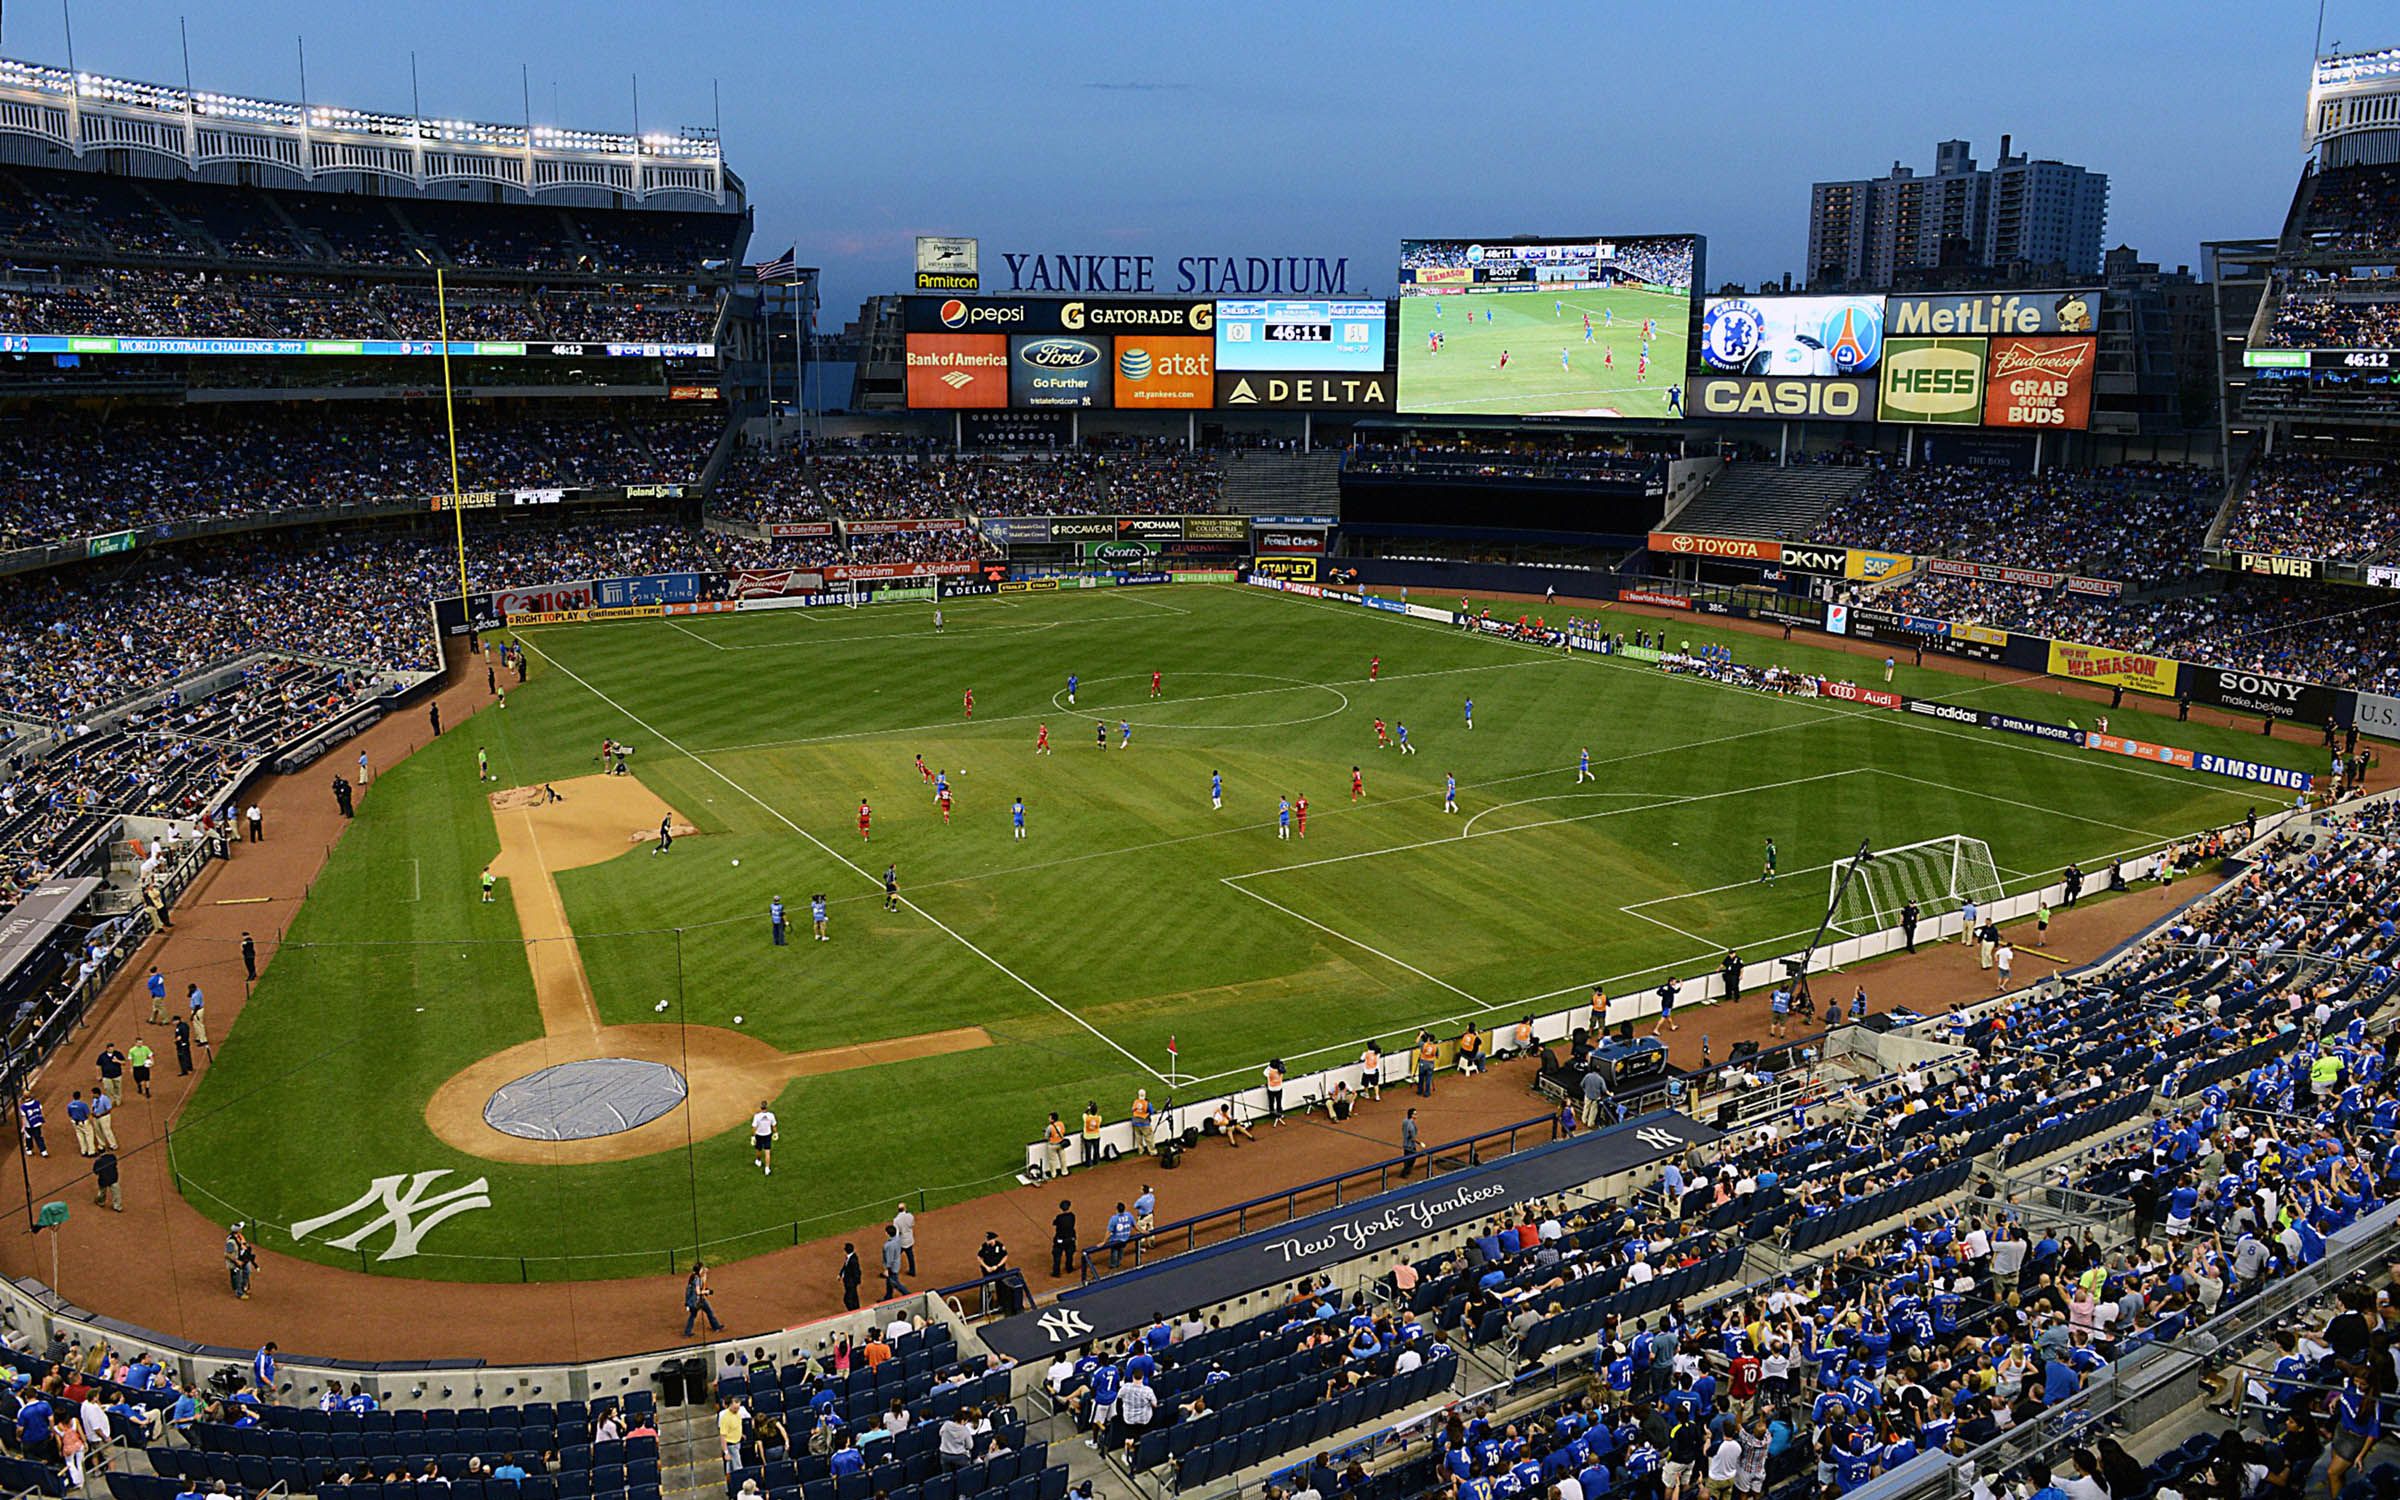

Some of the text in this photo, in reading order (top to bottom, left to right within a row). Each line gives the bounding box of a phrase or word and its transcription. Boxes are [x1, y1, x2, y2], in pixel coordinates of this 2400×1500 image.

[918, 274, 978, 288] Armitron
[1002, 253, 1349, 295] YANKEE STADIUM
[971, 305, 1024, 324] pepsi
[1061, 302, 1213, 330] G GATORADE G
[1713, 301, 1759, 319] CHELSEA
[1896, 295, 2041, 333] MetLife
[1273, 325, 1322, 341] 46:11
[120, 340, 157, 352] WORLD
[160, 341, 209, 352] FOOTBALL
[212, 342, 274, 353] CHALLENGE
[278, 342, 302, 353] 2012
[552, 344, 583, 356] 46:12
[1036, 343, 1085, 364] Ford
[907, 352, 1007, 366] Bank of America
[1158, 353, 1209, 376] at&t
[1996, 350, 2084, 371] Budweiser
[2344, 353, 2389, 367] 46:12
[1033, 378, 1088, 389] Go Further
[1890, 368, 1976, 394] HESS
[2010, 380, 2069, 398] GRAB
[1269, 379, 1385, 404] DELTA
[1704, 381, 1860, 416] CASIO
[2018, 396, 2057, 408] SOME
[2008, 407, 2065, 425] BUDS
[627, 486, 654, 499] Poland
[1061, 524, 1113, 535] ROCAWEAR
[1132, 521, 1180, 530] YOKOHAMA
[1103, 546, 1141, 557] Scotts
[1696, 538, 1758, 557] TOYOTA
[1261, 563, 1310, 575] STANLEY
[1782, 550, 1846, 571] DKNY
[1864, 559, 1889, 574] SAP
[1933, 561, 1975, 575] MODELL'S
[1763, 569, 1787, 581] FedEx
[2004, 570, 2049, 585] MODELL'S
[810, 592, 868, 605] SAMSUNG
[957, 585, 992, 595] DELTA
[496, 588, 591, 615] Canon
[515, 611, 579, 624] RIGHT TO PLAY
[587, 608, 634, 618] Continental
[1560, 633, 1608, 653] SMSUNG
[2219, 672, 2304, 701] SONY
[1864, 692, 1892, 705] Audi
[2221, 693, 2295, 717] make.believe
[1936, 705, 1978, 724] adidas
[2361, 705, 2398, 726] U.S.
[2003, 718, 2071, 741] DREAM BIGGER.
[2201, 755, 2303, 788] SAMSUNG
[1264, 1183, 1505, 1263] New York Yankees
[2248, 1245, 2256, 1256] 8
[1917, 1320, 1934, 1338] 23
[1622, 1369, 1631, 1383] 11
[1744, 1369, 1757, 1384] 10
[2289, 1362, 2308, 1374] TORR
[1106, 1375, 1113, 1391] 7
[1852, 1387, 1867, 1406] 12
[1487, 1449, 1499, 1466] 26
[1474, 1482, 1493, 1500] 12
